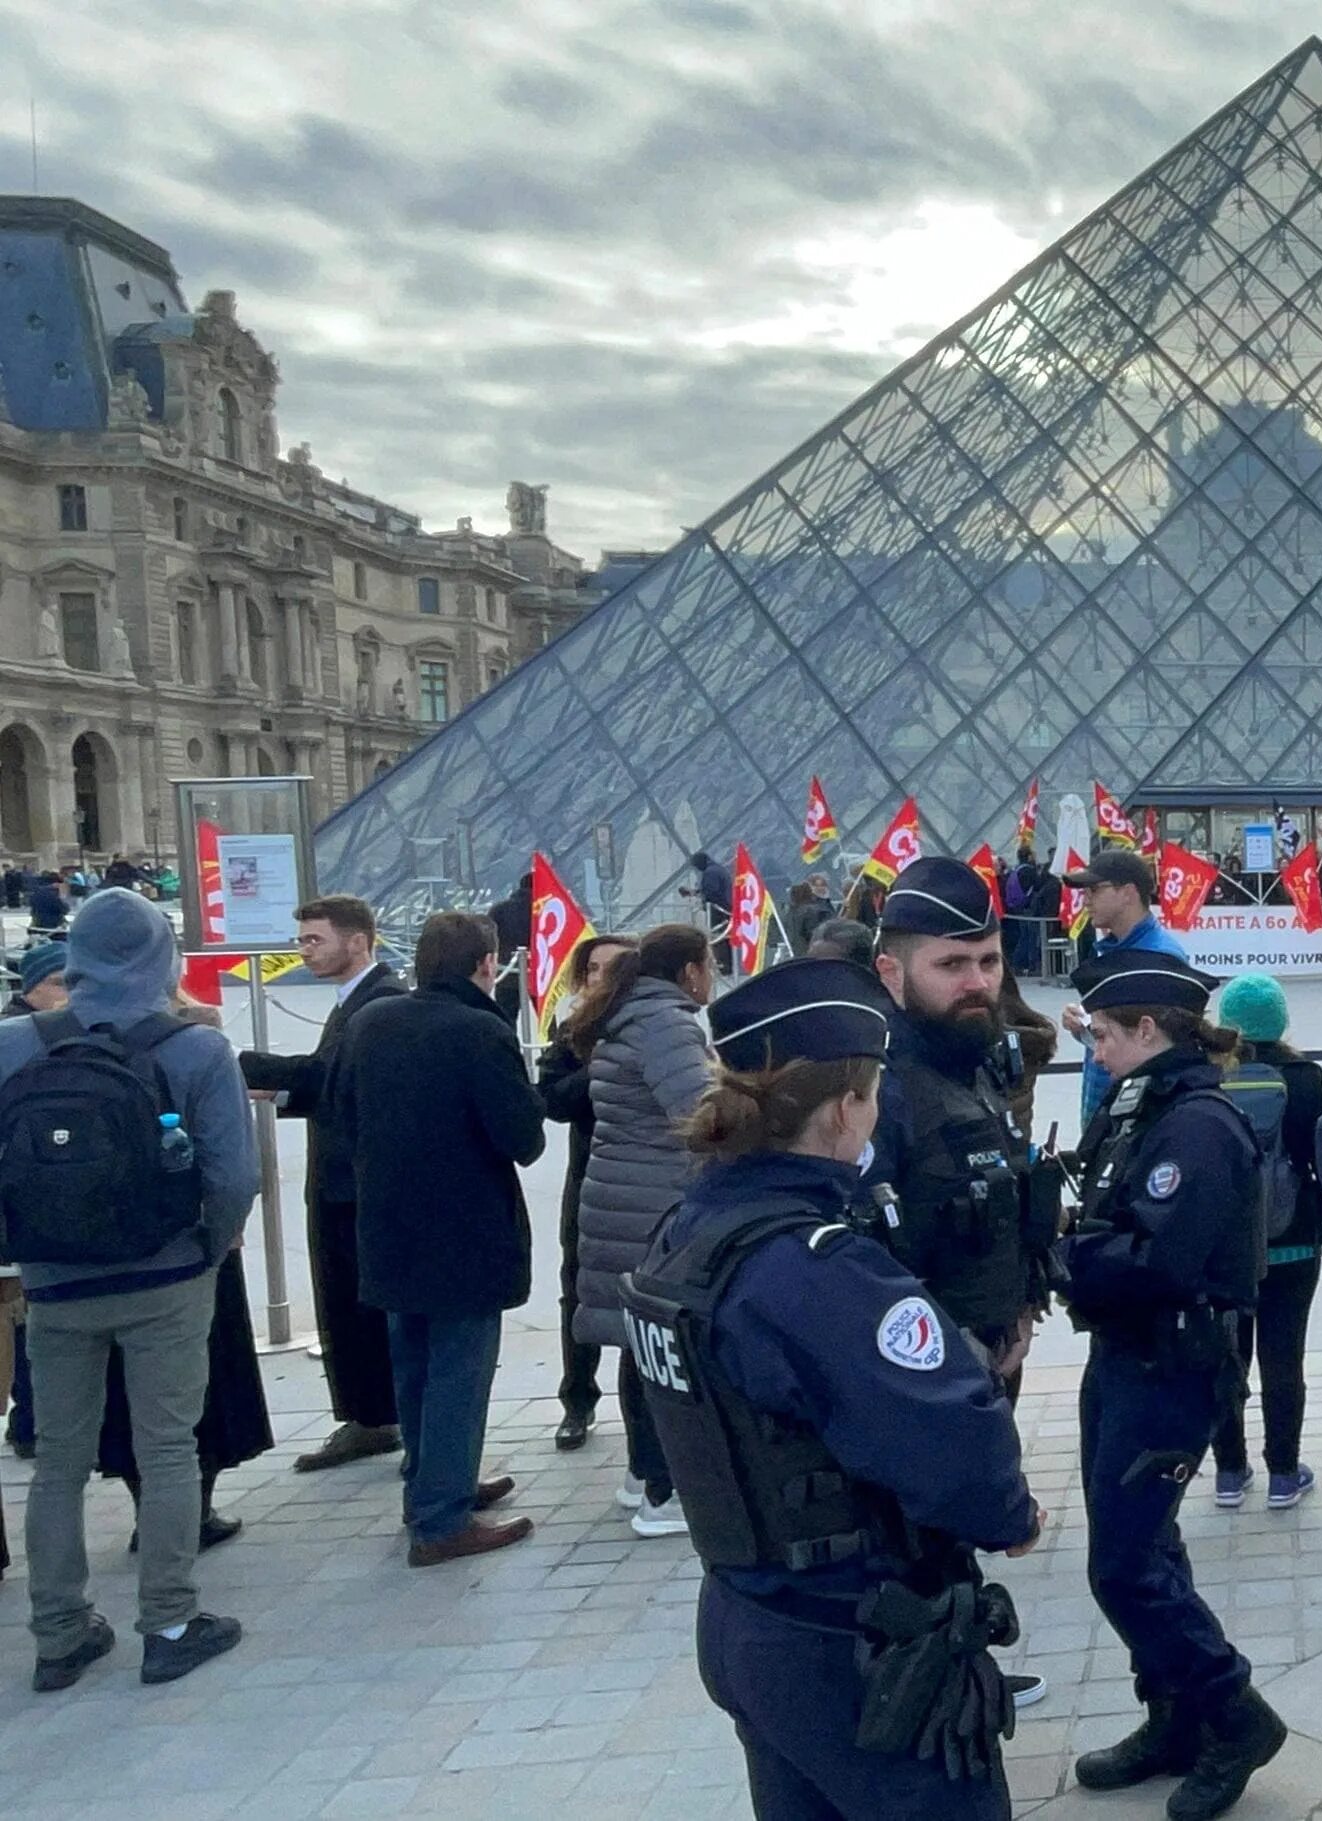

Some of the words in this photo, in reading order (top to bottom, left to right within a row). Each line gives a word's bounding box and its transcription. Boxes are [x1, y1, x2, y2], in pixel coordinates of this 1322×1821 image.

[1157, 915, 1245, 930] RRAITE
[1266, 915, 1288, 929] 60
[1195, 952, 1242, 966] MOINS
[1247, 952, 1288, 965] POUR
[623, 1306, 689, 1393] LICE
